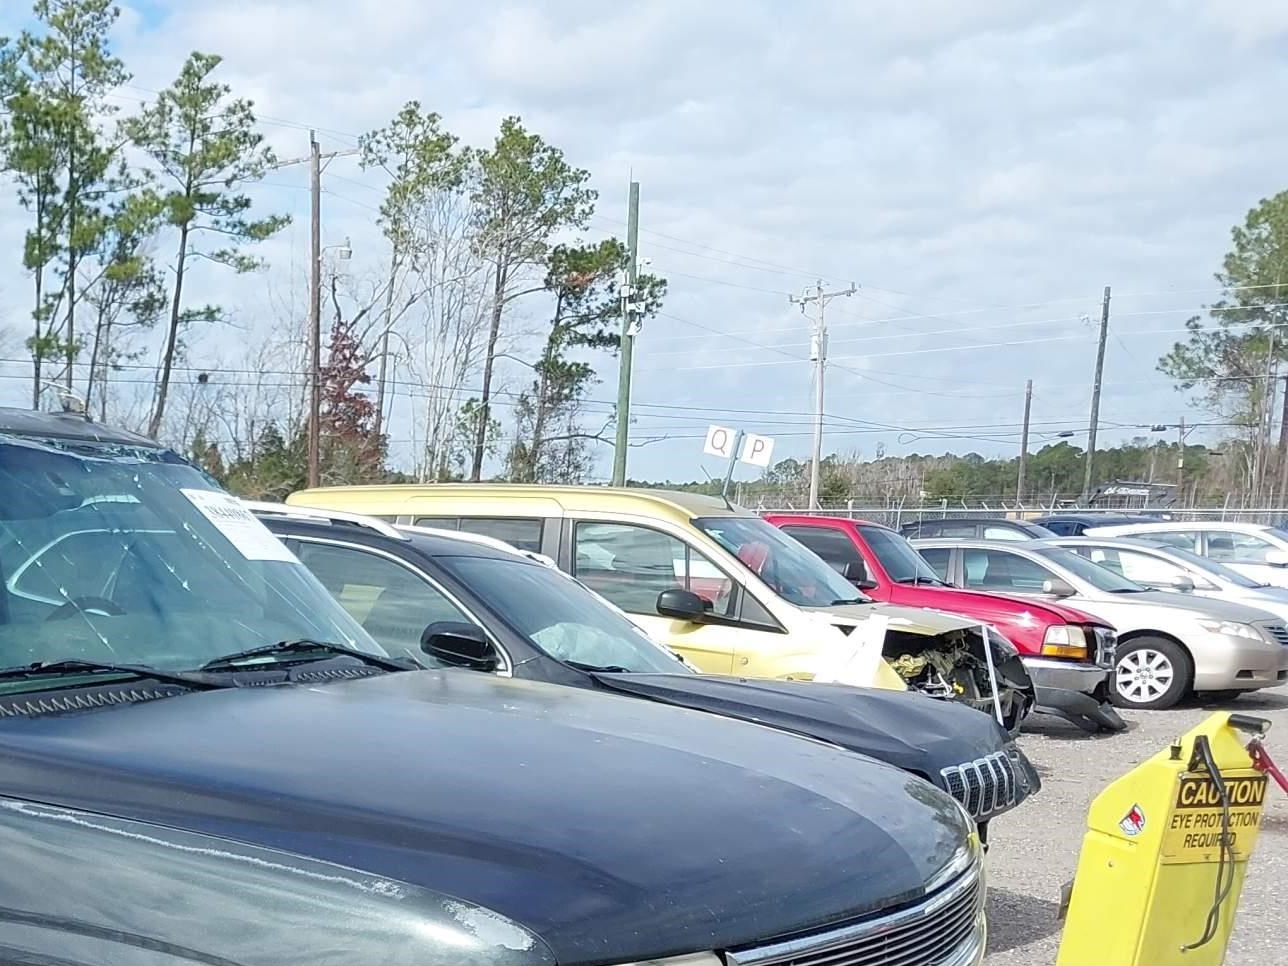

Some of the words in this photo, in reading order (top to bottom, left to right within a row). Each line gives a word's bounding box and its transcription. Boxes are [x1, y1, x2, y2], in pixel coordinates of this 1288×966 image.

[711, 429, 727, 455] Q
[750, 439, 765, 459] P
[1181, 780, 1266, 805] CAUTION
[1171, 813, 1194, 829] EYE
[1194, 811, 1260, 828] PROTCTION
[1183, 832, 1237, 848] REQUIRD
